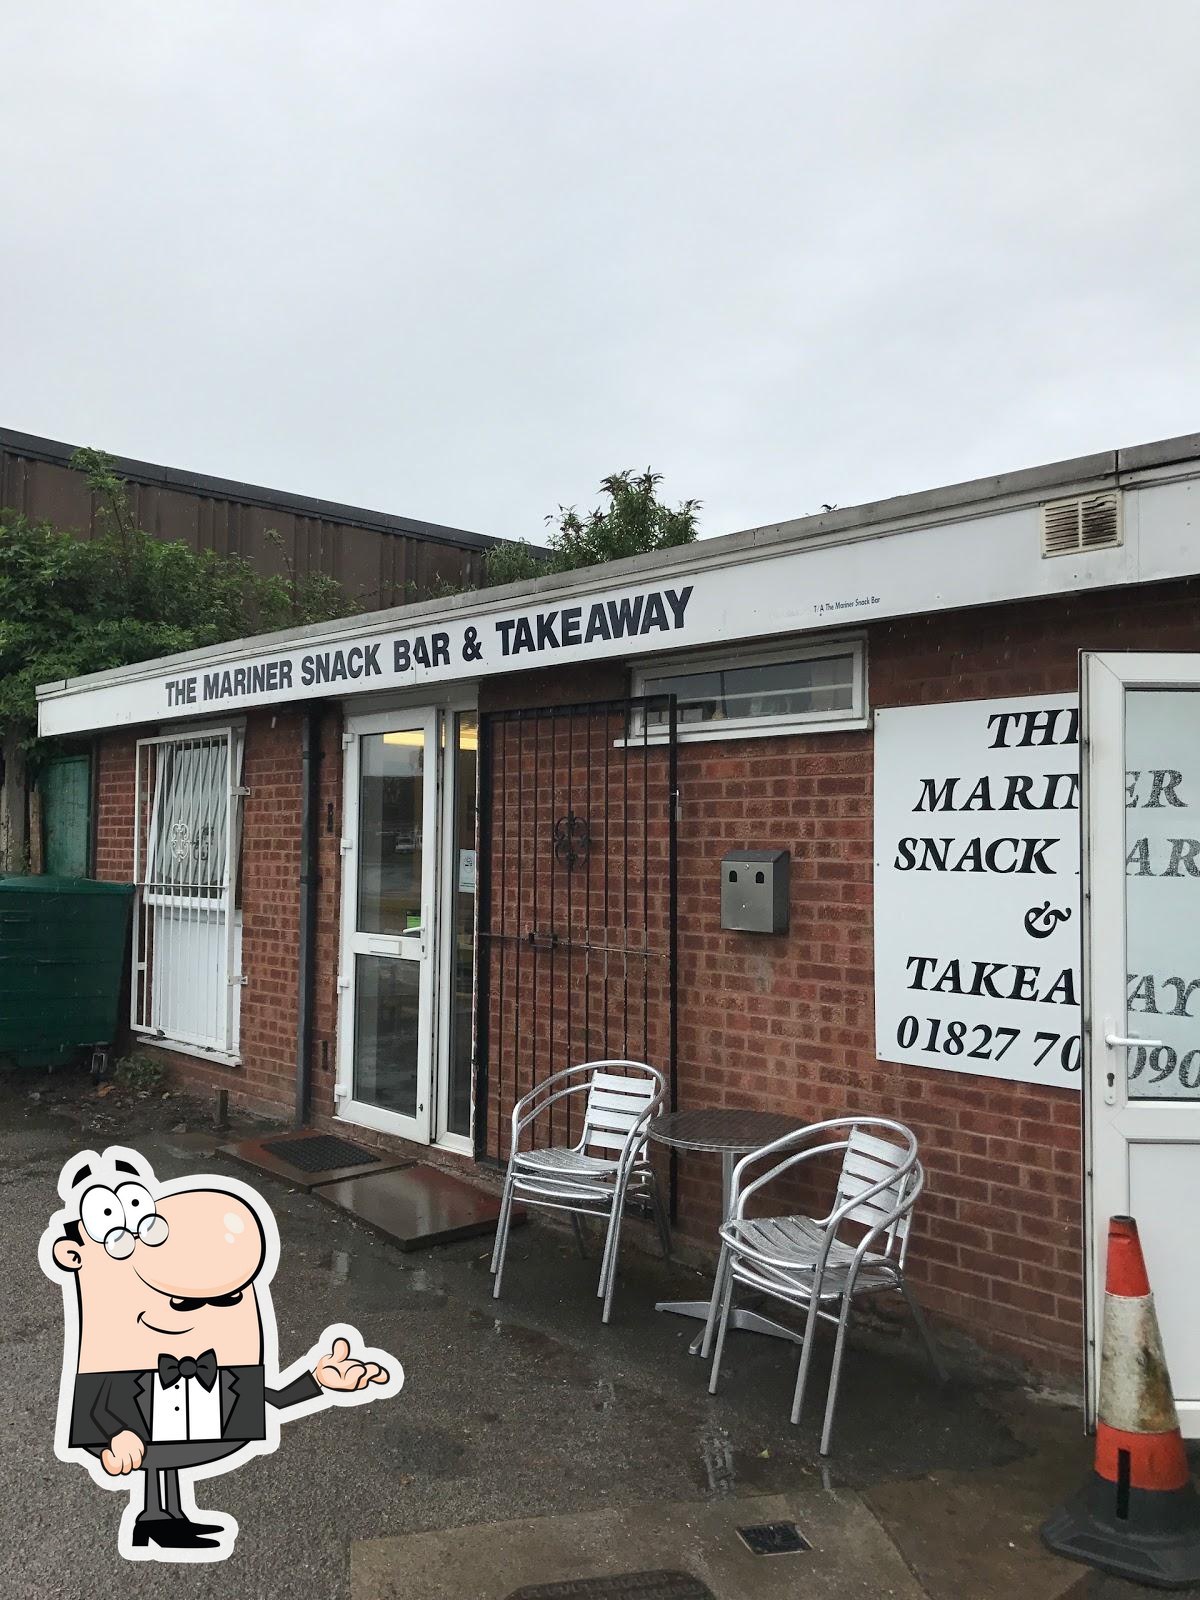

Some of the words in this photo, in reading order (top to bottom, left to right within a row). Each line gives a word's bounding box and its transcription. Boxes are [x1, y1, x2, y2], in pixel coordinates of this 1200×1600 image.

[871, 596, 880, 604] Bar
[165, 676, 197, 707] THE
[203, 659, 292, 700] MARINER
[301, 643, 381, 686] SNACK
[393, 633, 450, 672] BAR
[462, 626, 482, 661] &
[495, 586, 694, 655] TAKEAWAY
[893, 836, 1060, 875] SNACK
[1024, 901, 1071, 939] &
[906, 956, 1200, 1017] TAKEAAY
[896, 1015, 1020, 1062] 01827
